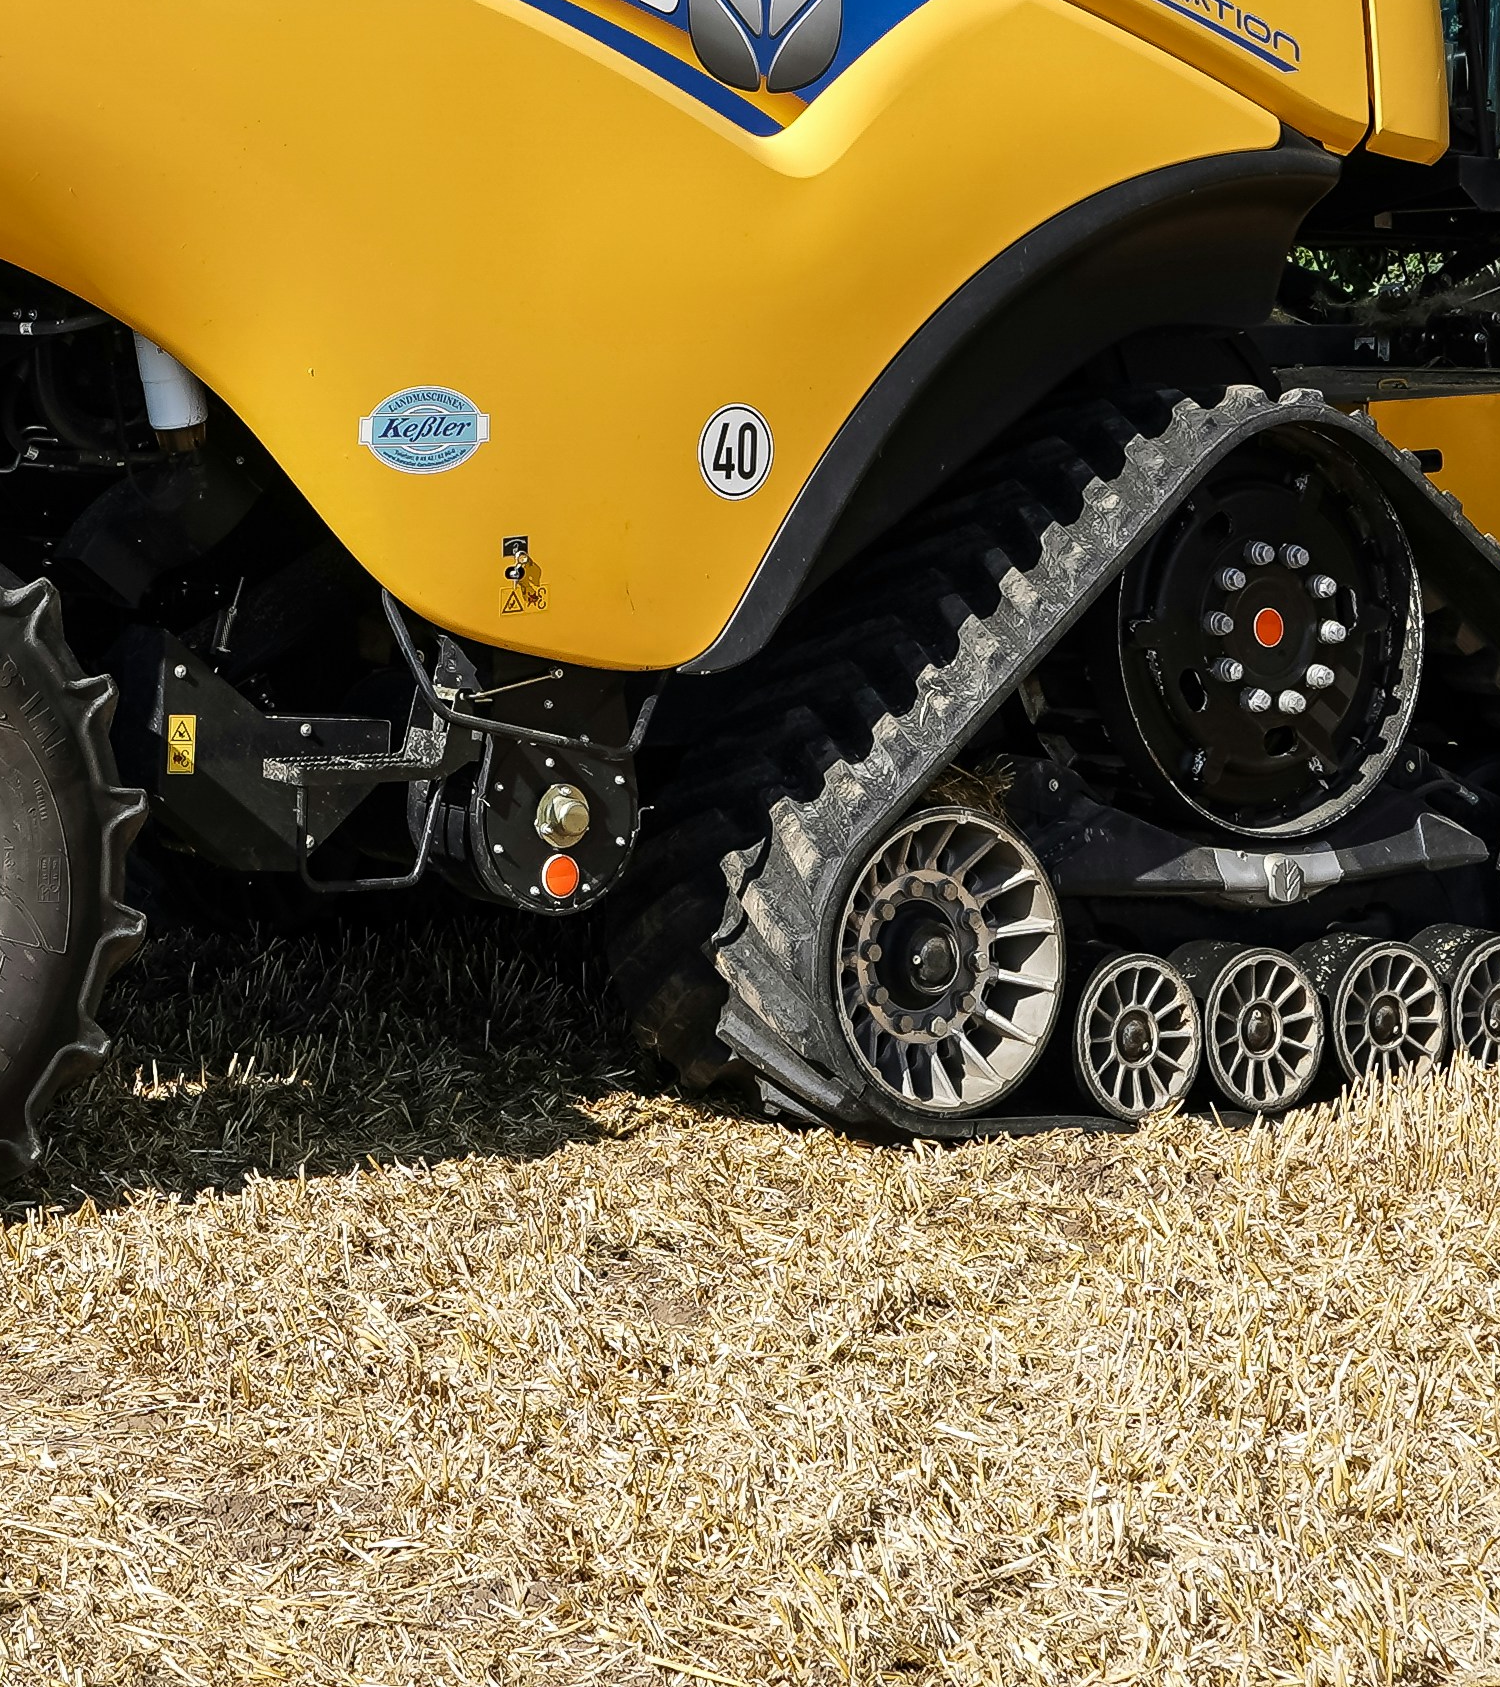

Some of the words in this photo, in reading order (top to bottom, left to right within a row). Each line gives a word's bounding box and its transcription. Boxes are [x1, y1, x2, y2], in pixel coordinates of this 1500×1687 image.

[388, 392, 465, 413] LANDMASCHINEN
[378, 415, 472, 443] Keßler
[712, 422, 758, 481] 40
